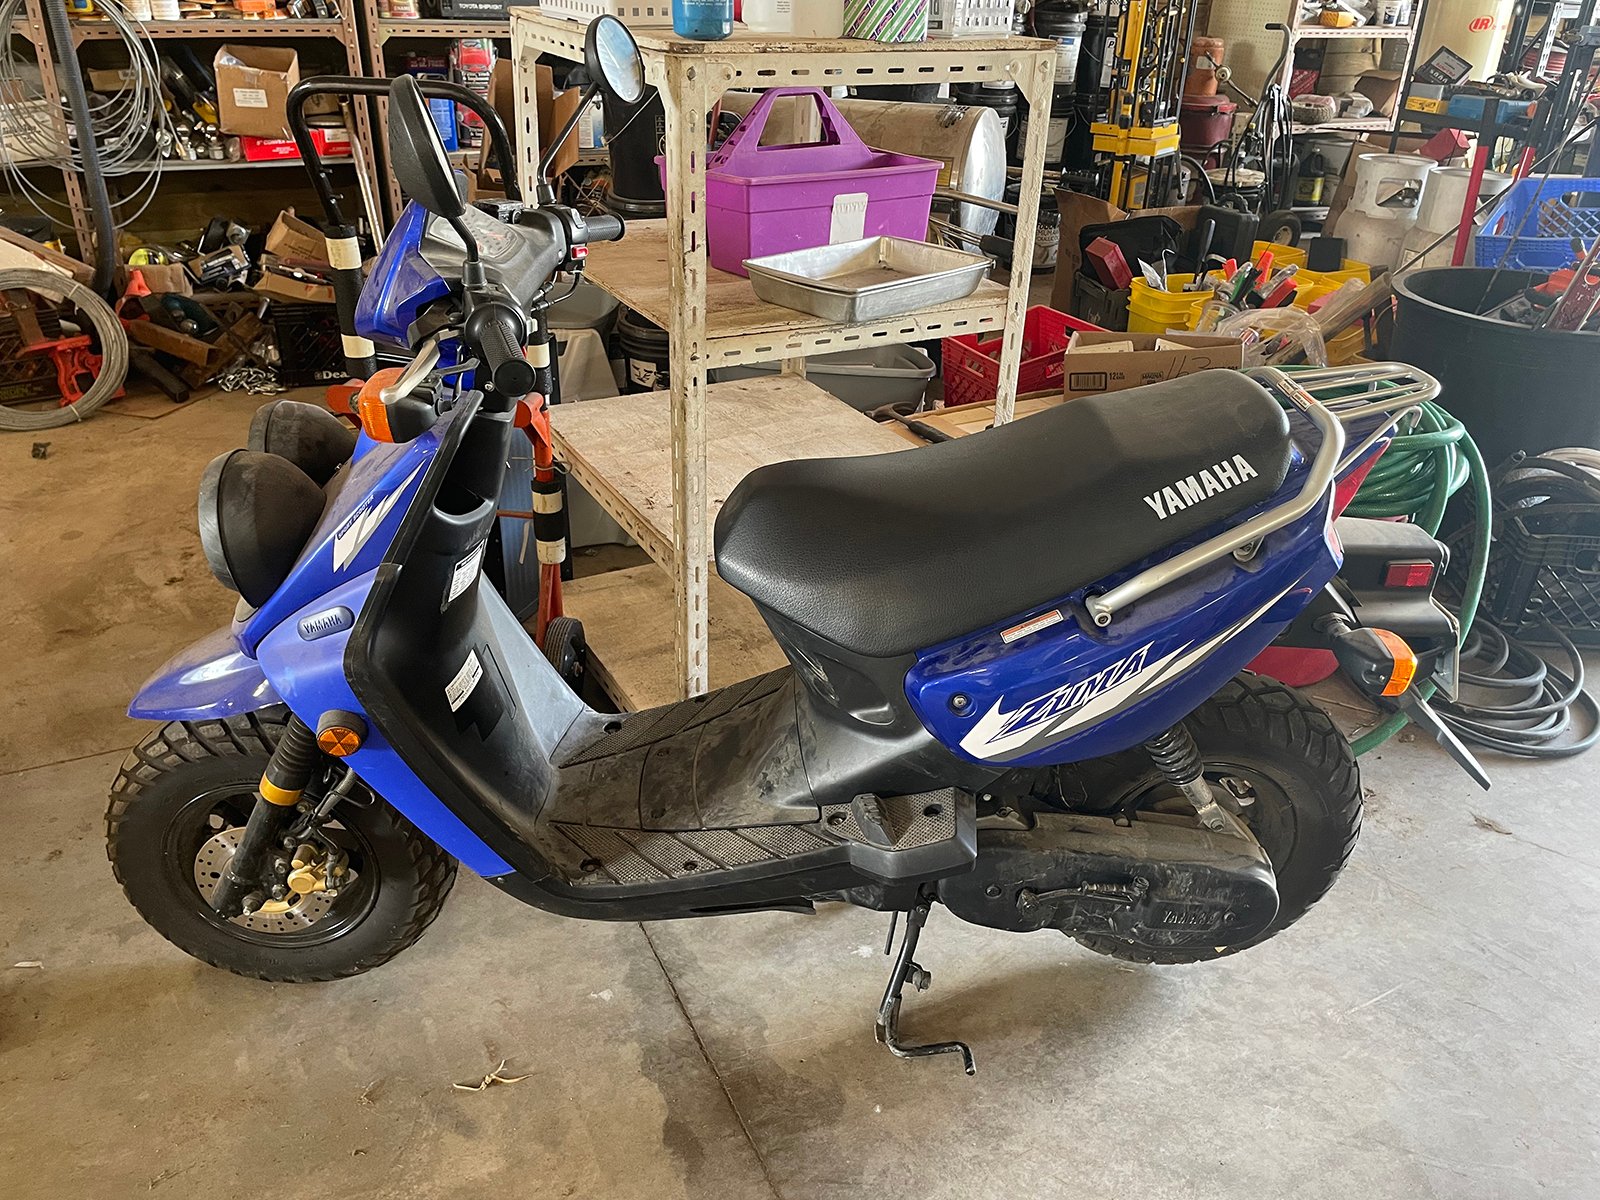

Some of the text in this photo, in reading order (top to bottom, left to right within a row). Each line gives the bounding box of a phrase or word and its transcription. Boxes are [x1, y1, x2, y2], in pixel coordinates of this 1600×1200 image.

[1471, 17, 1492, 30] IR
[322, 370, 349, 379] Dea
[1142, 453, 1259, 520] YAMAHA
[302, 614, 343, 634] YAMAHA
[992, 642, 1154, 741] ZUMA
